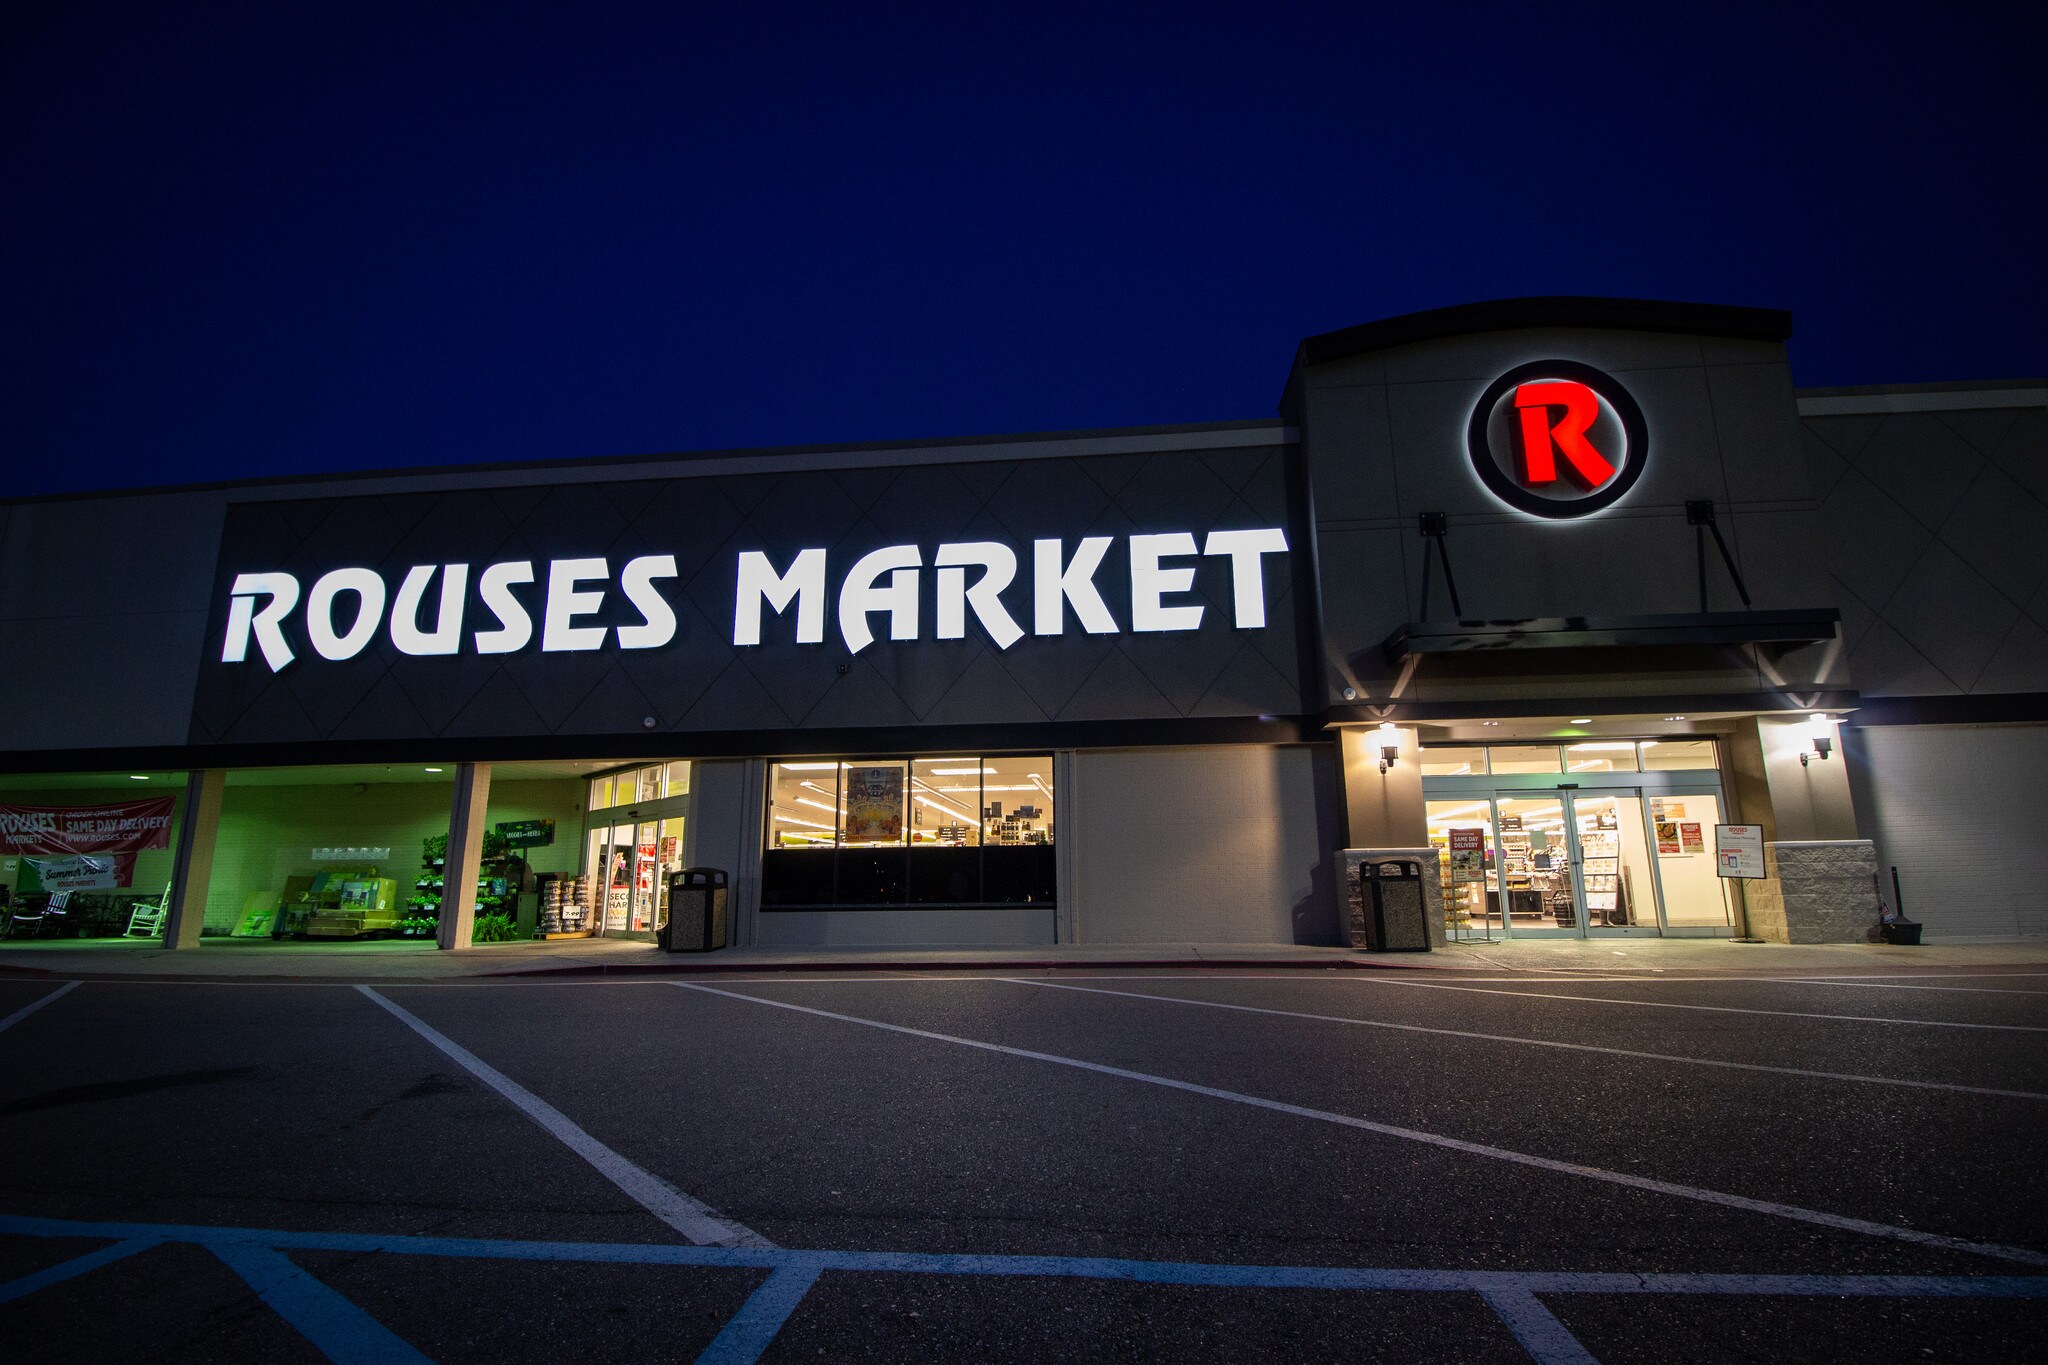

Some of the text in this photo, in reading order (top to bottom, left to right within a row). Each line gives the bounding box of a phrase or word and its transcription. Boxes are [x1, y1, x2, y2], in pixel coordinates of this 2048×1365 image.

[1515, 381, 1616, 488] R
[221, 528, 1289, 674] ROUSES MARKET
[94, 809, 124, 817] ONLINE
[0, 813, 57, 834] ROUSES
[66, 816, 169, 833] SAME DAY DELIVERY
[5, 835, 43, 845] MARKETS
[65, 833, 141, 842] WWW.ROUSES.COM
[45, 864, 109, 880] Summer Picnic
